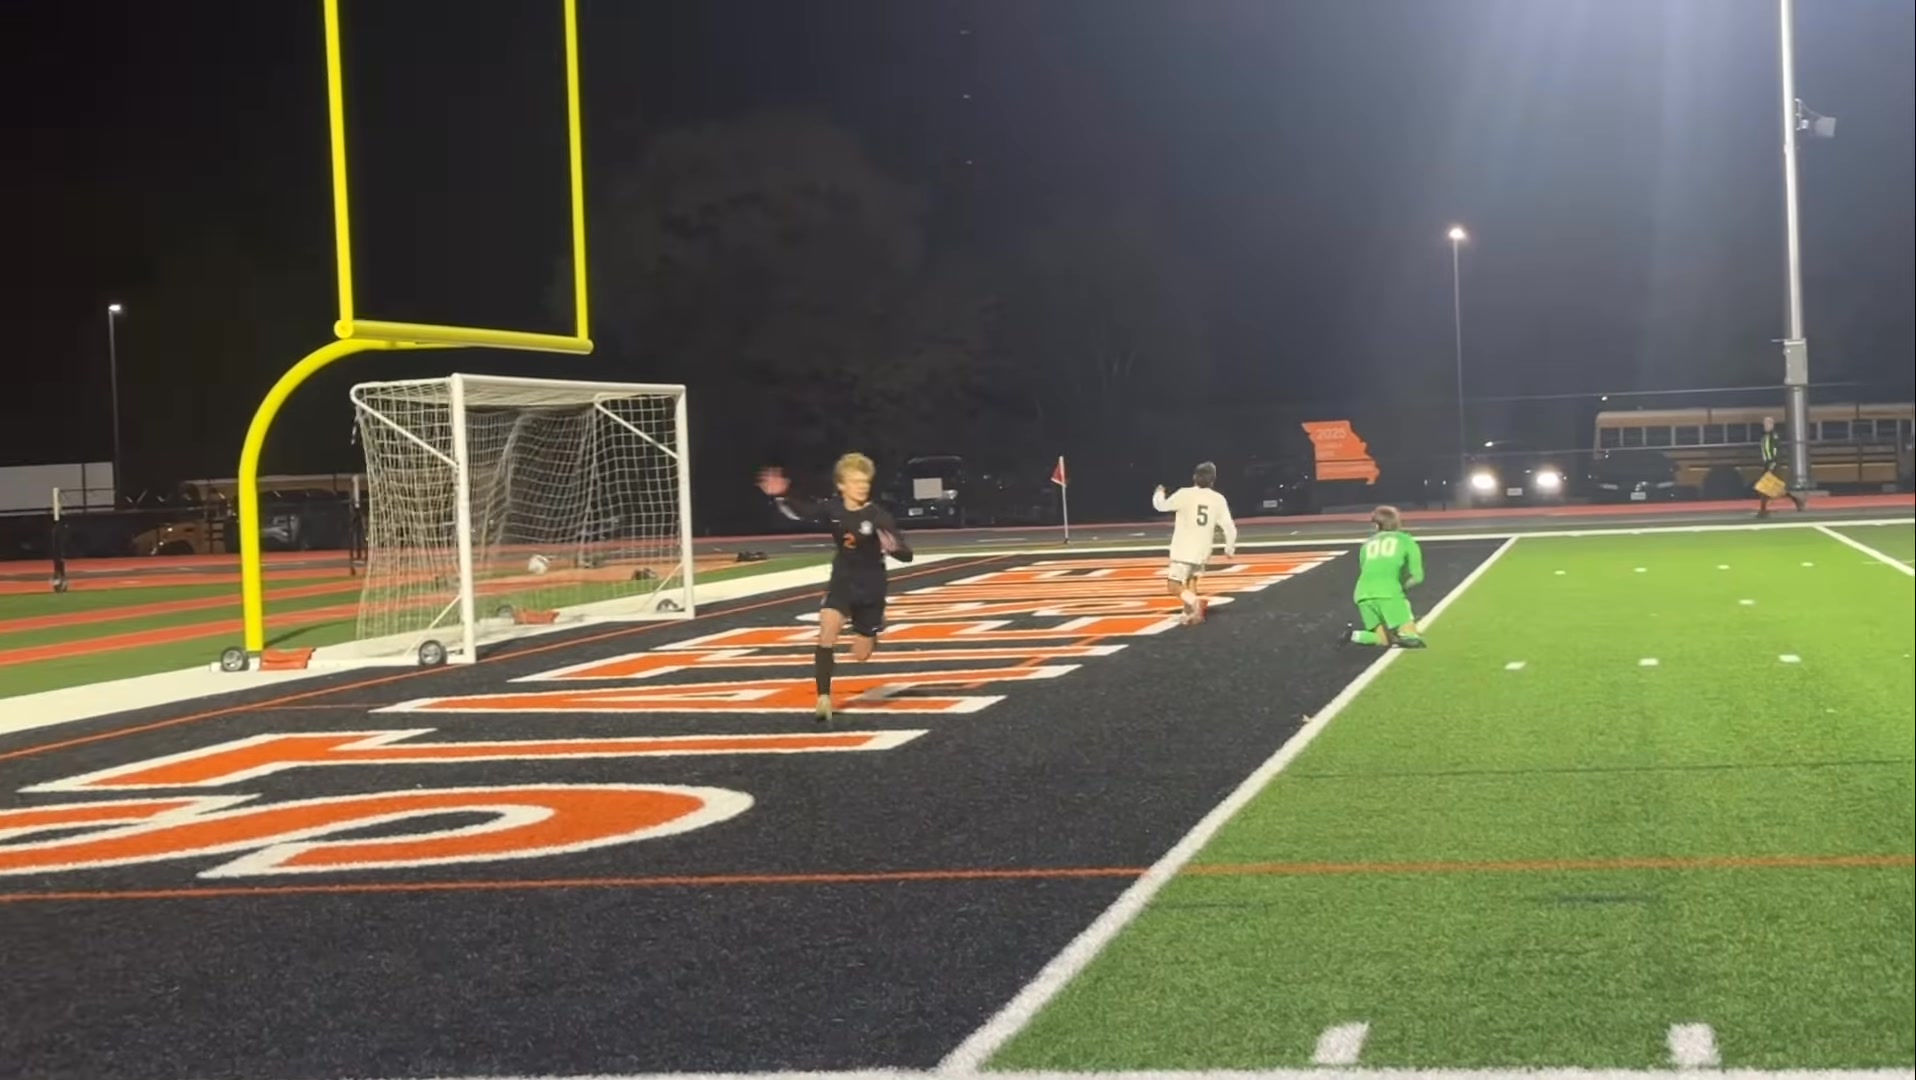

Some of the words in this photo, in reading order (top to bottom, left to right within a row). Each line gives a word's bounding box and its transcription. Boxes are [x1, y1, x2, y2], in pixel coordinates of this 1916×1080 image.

[1196, 504, 1208, 527] 5
[843, 532, 857, 549] 2
[1366, 537, 1398, 558] 00
